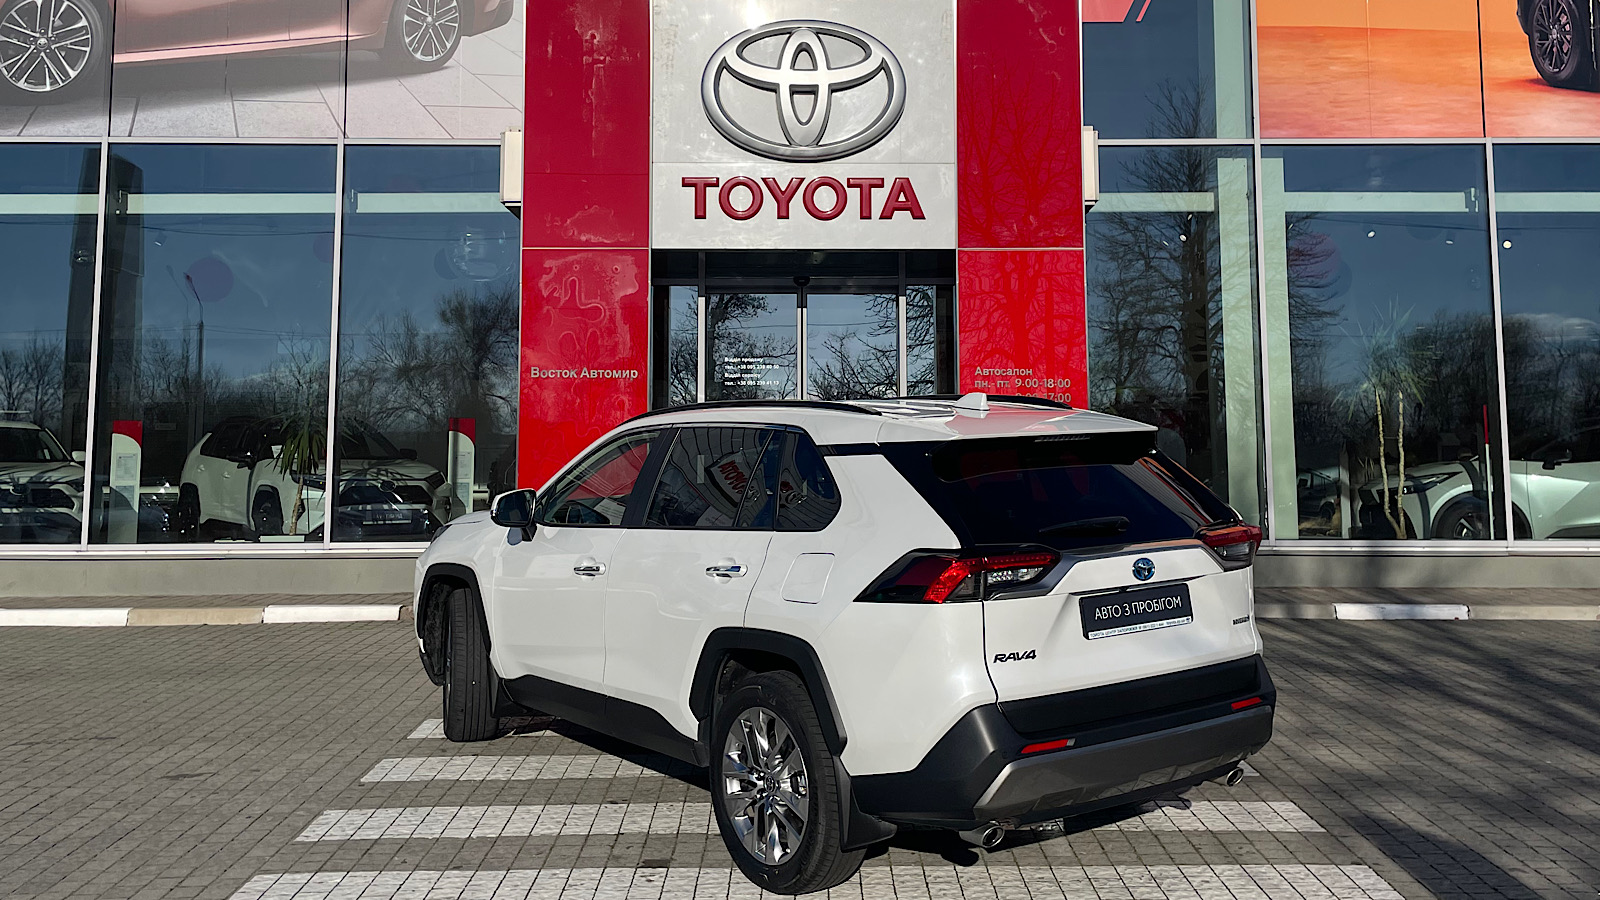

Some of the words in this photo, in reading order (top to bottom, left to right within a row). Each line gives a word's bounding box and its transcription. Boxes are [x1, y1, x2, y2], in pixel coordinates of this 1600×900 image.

[681, 176, 926, 221] TOYOTA
[530, 366, 577, 378] Восток
[580, 366, 638, 381] Автомир
[974, 366, 1033, 376] Автосалон
[1095, 605, 1122, 620] АВТО
[1123, 603, 1131, 616] З
[1132, 596, 1182, 615] ПРОБІГОМ
[993, 649, 1037, 664] RAV4
